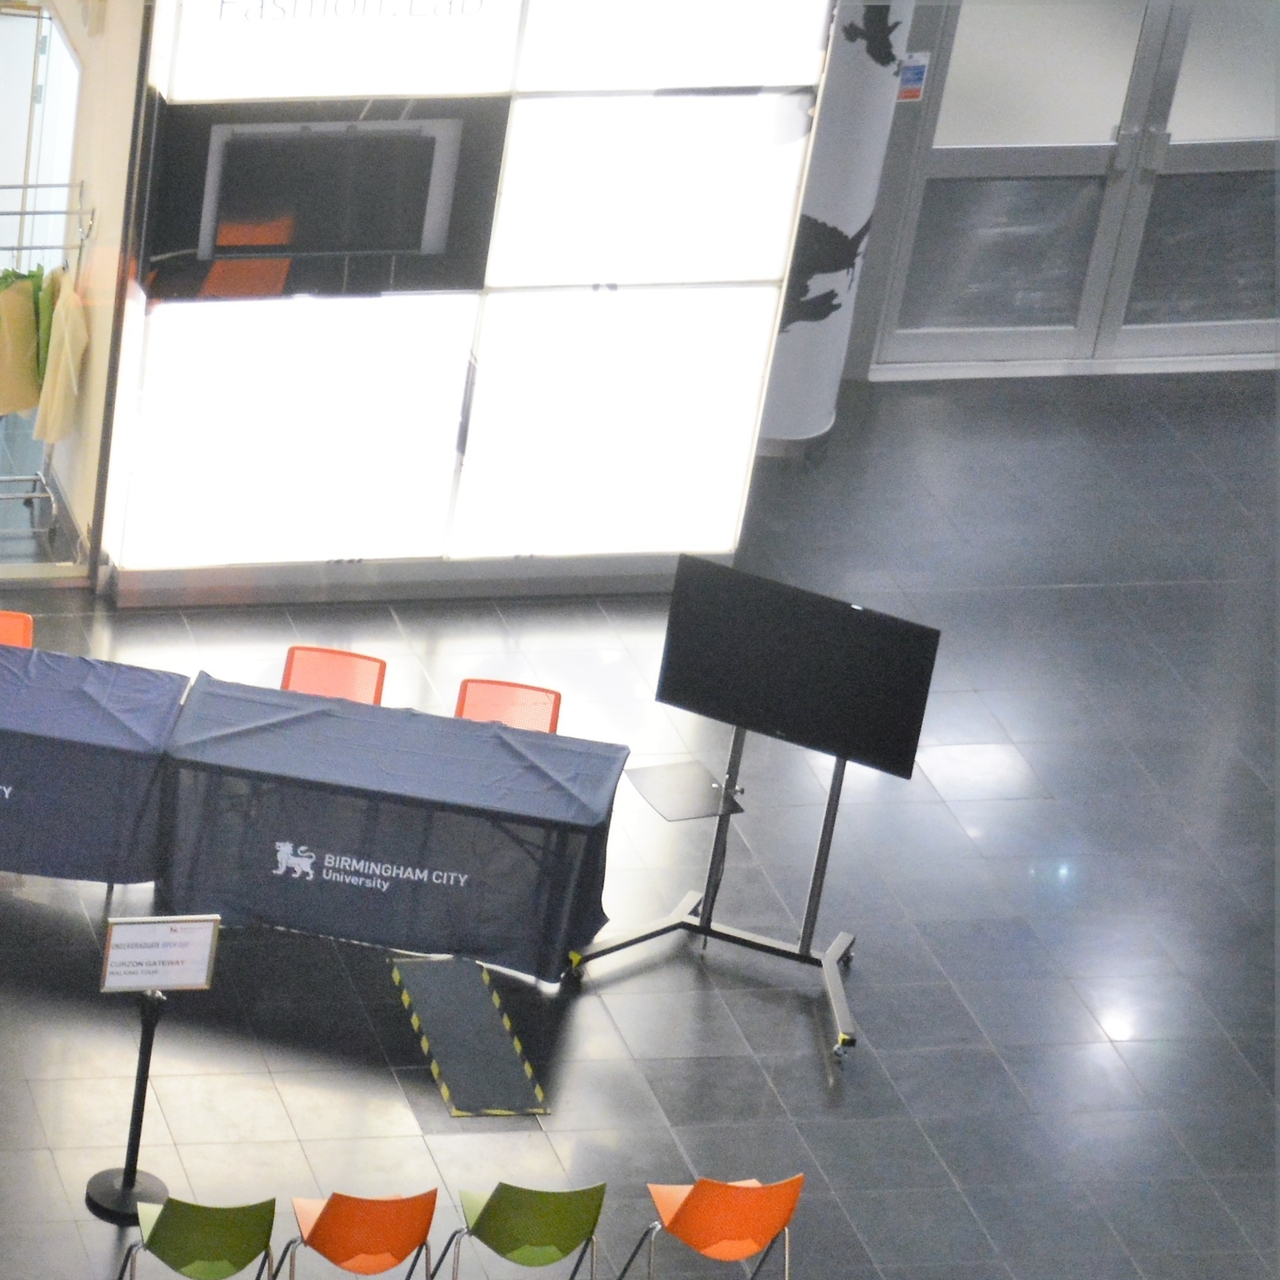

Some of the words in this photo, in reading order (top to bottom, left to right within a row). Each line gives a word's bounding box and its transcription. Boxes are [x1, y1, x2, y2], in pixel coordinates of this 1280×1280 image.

[322, 868, 390, 892] University
[324, 853, 429, 882] BIRMINGHAM
[431, 870, 469, 887] CITY
